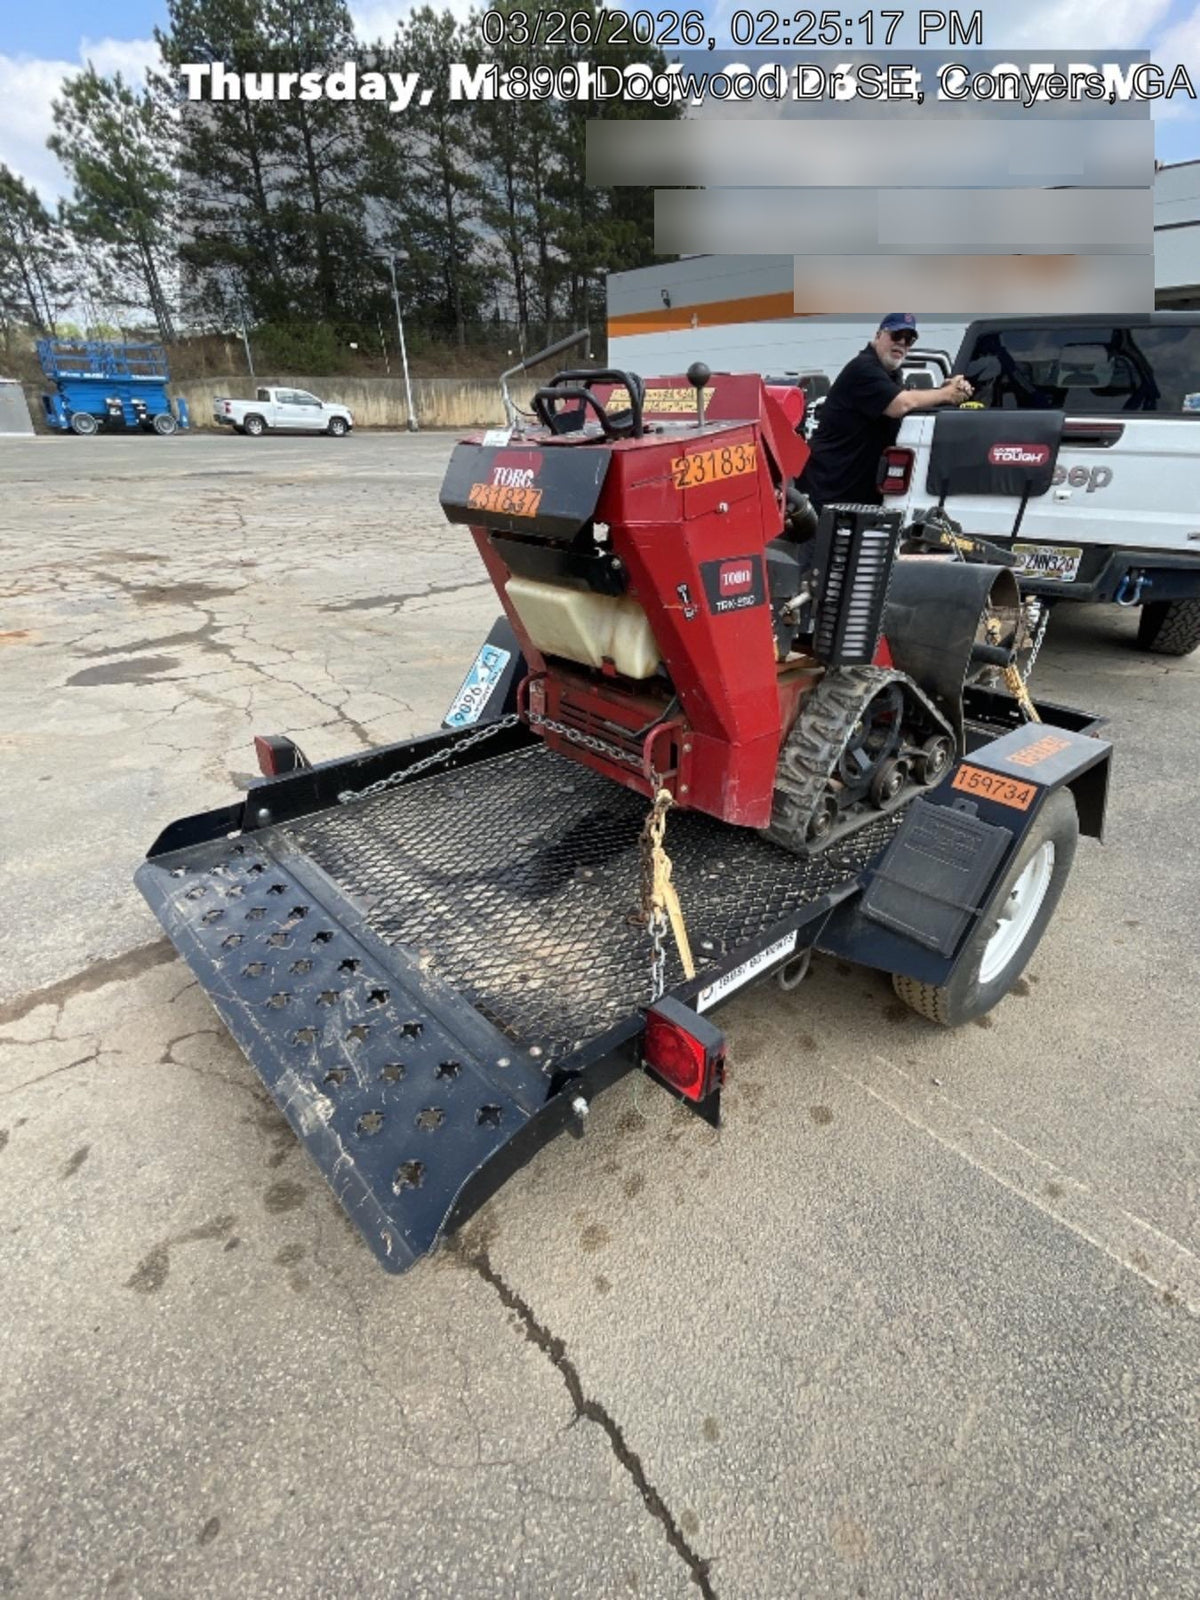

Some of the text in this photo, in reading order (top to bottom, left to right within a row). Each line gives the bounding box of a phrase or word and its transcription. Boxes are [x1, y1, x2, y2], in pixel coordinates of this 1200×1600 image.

[993, 452, 1044, 463] TOUGH
[1051, 464, 1113, 493] eep
[959, 770, 1031, 804] 159734
